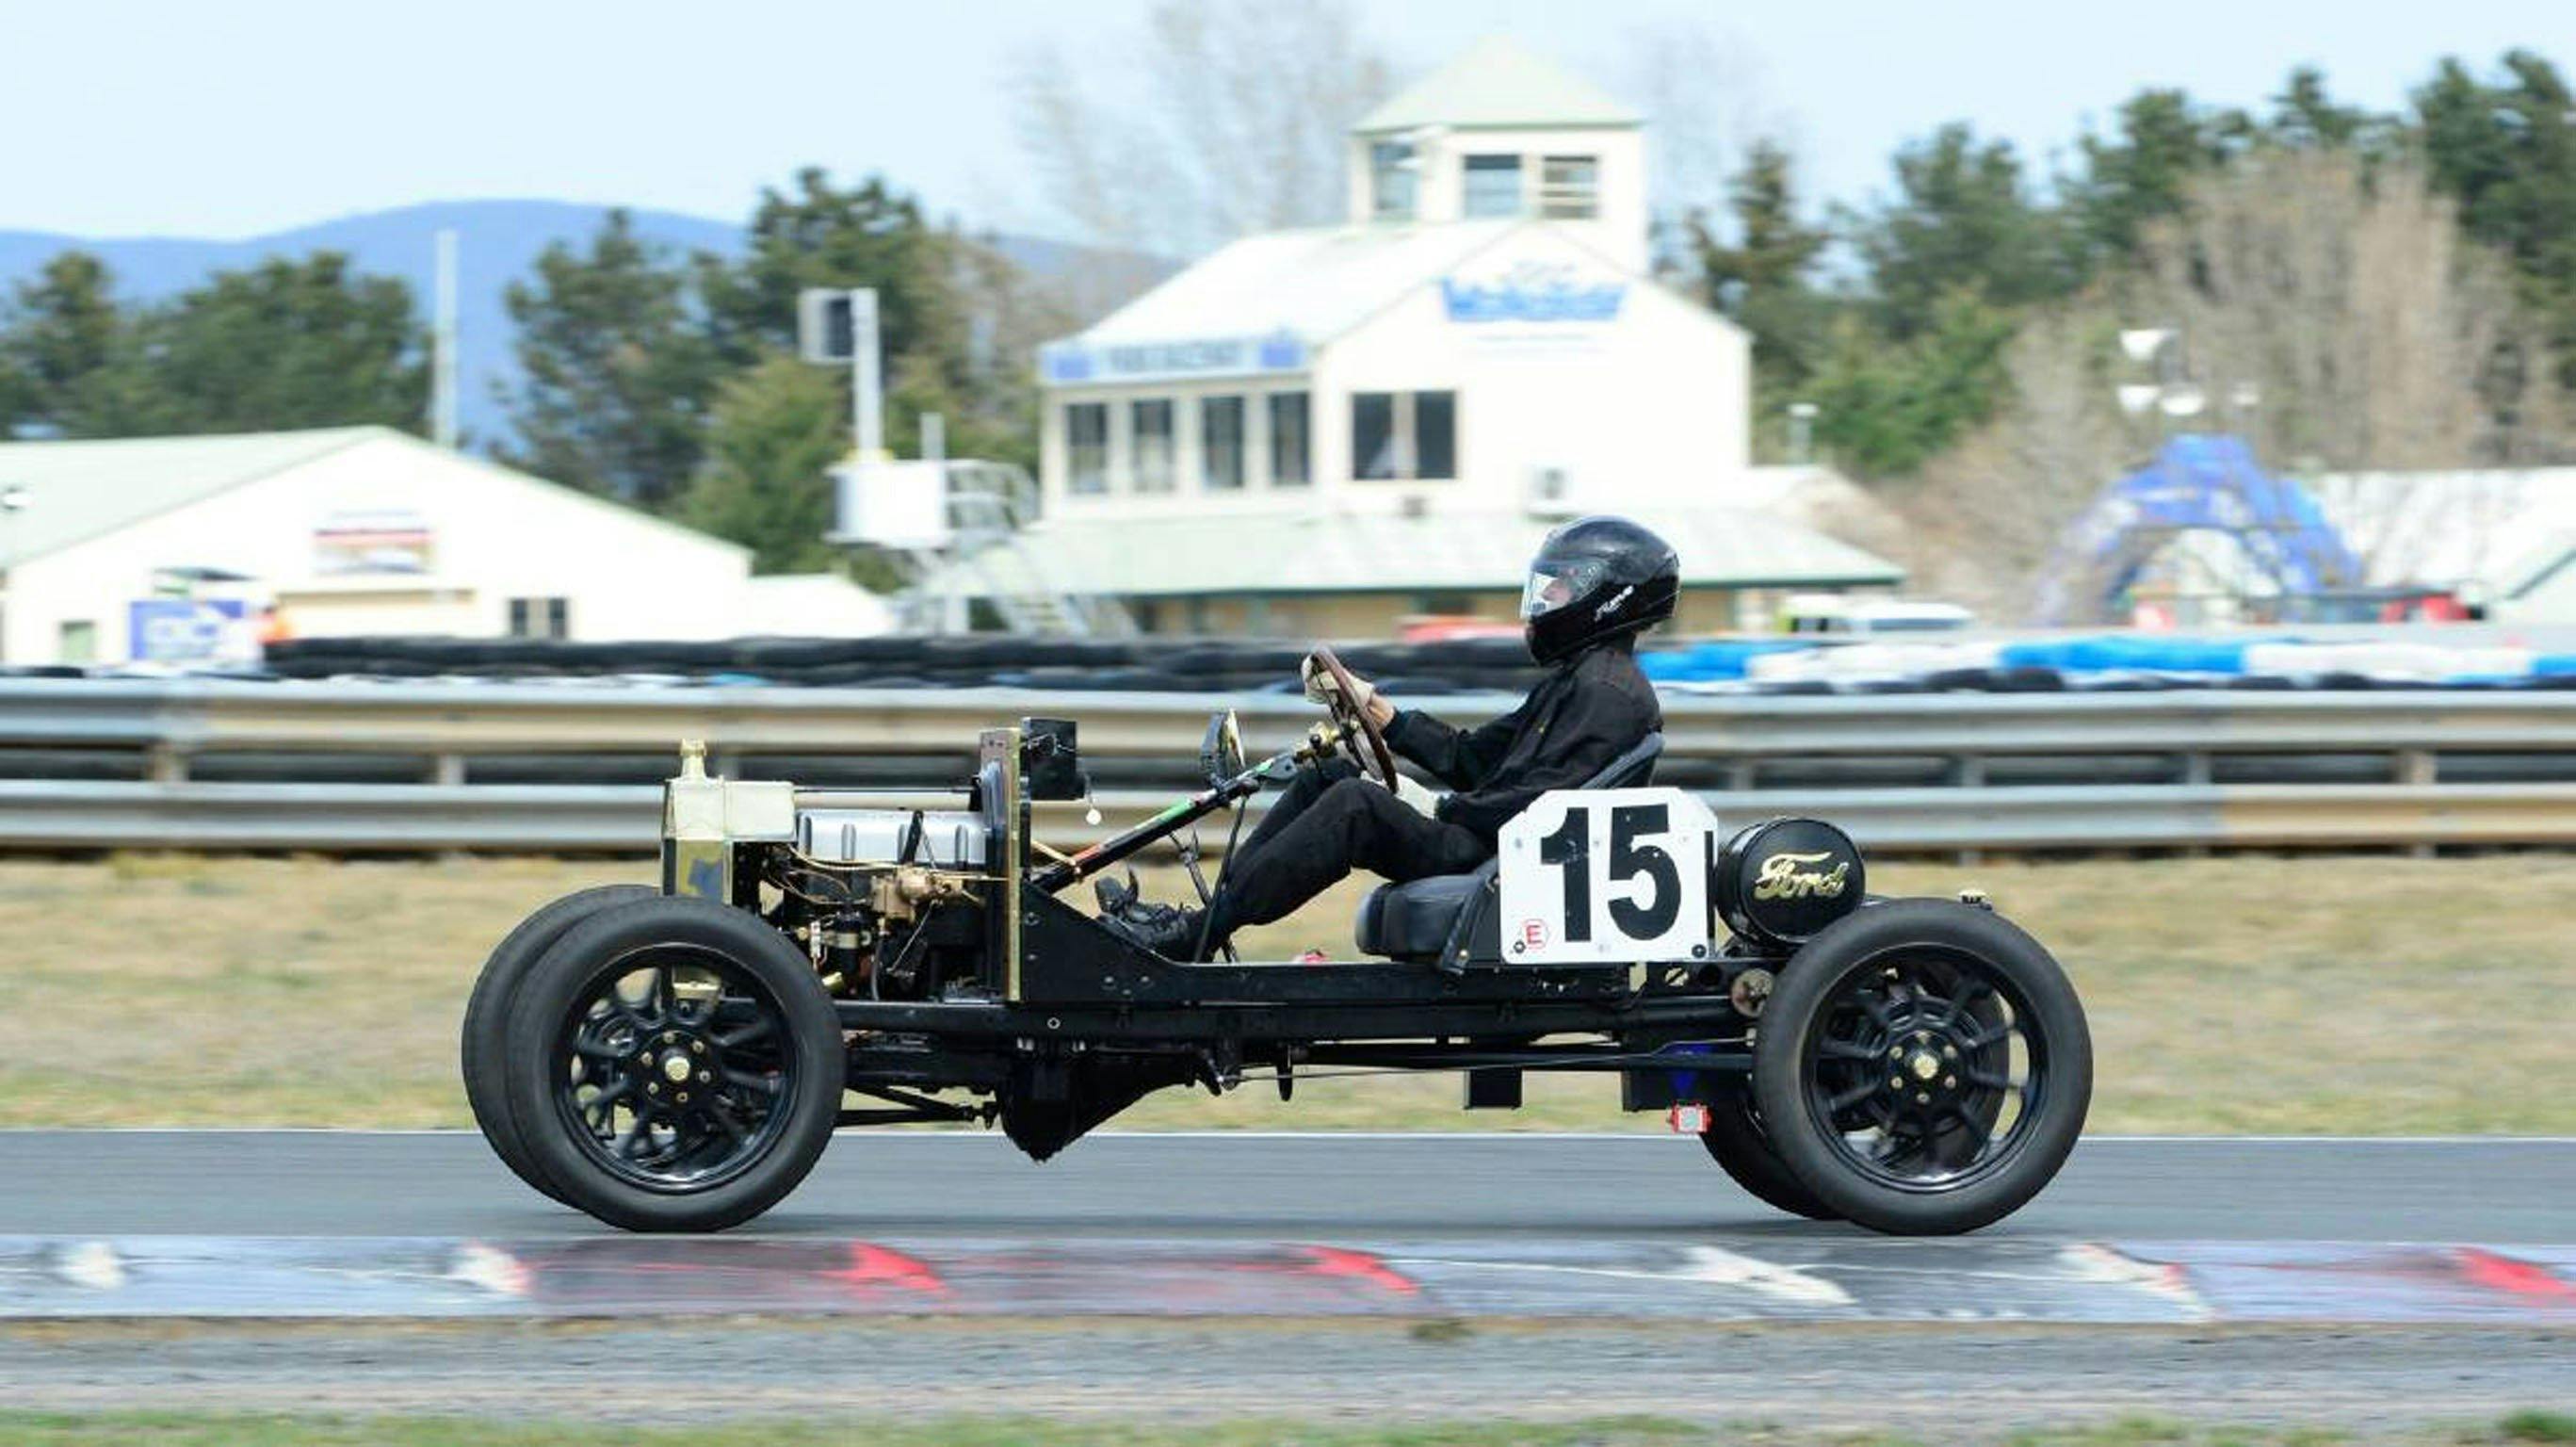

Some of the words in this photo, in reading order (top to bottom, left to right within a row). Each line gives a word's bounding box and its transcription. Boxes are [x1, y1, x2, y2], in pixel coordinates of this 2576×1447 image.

[1541, 804, 1681, 942] 15
[1754, 852, 1849, 900] Ford
[1526, 924, 1543, 945] E
